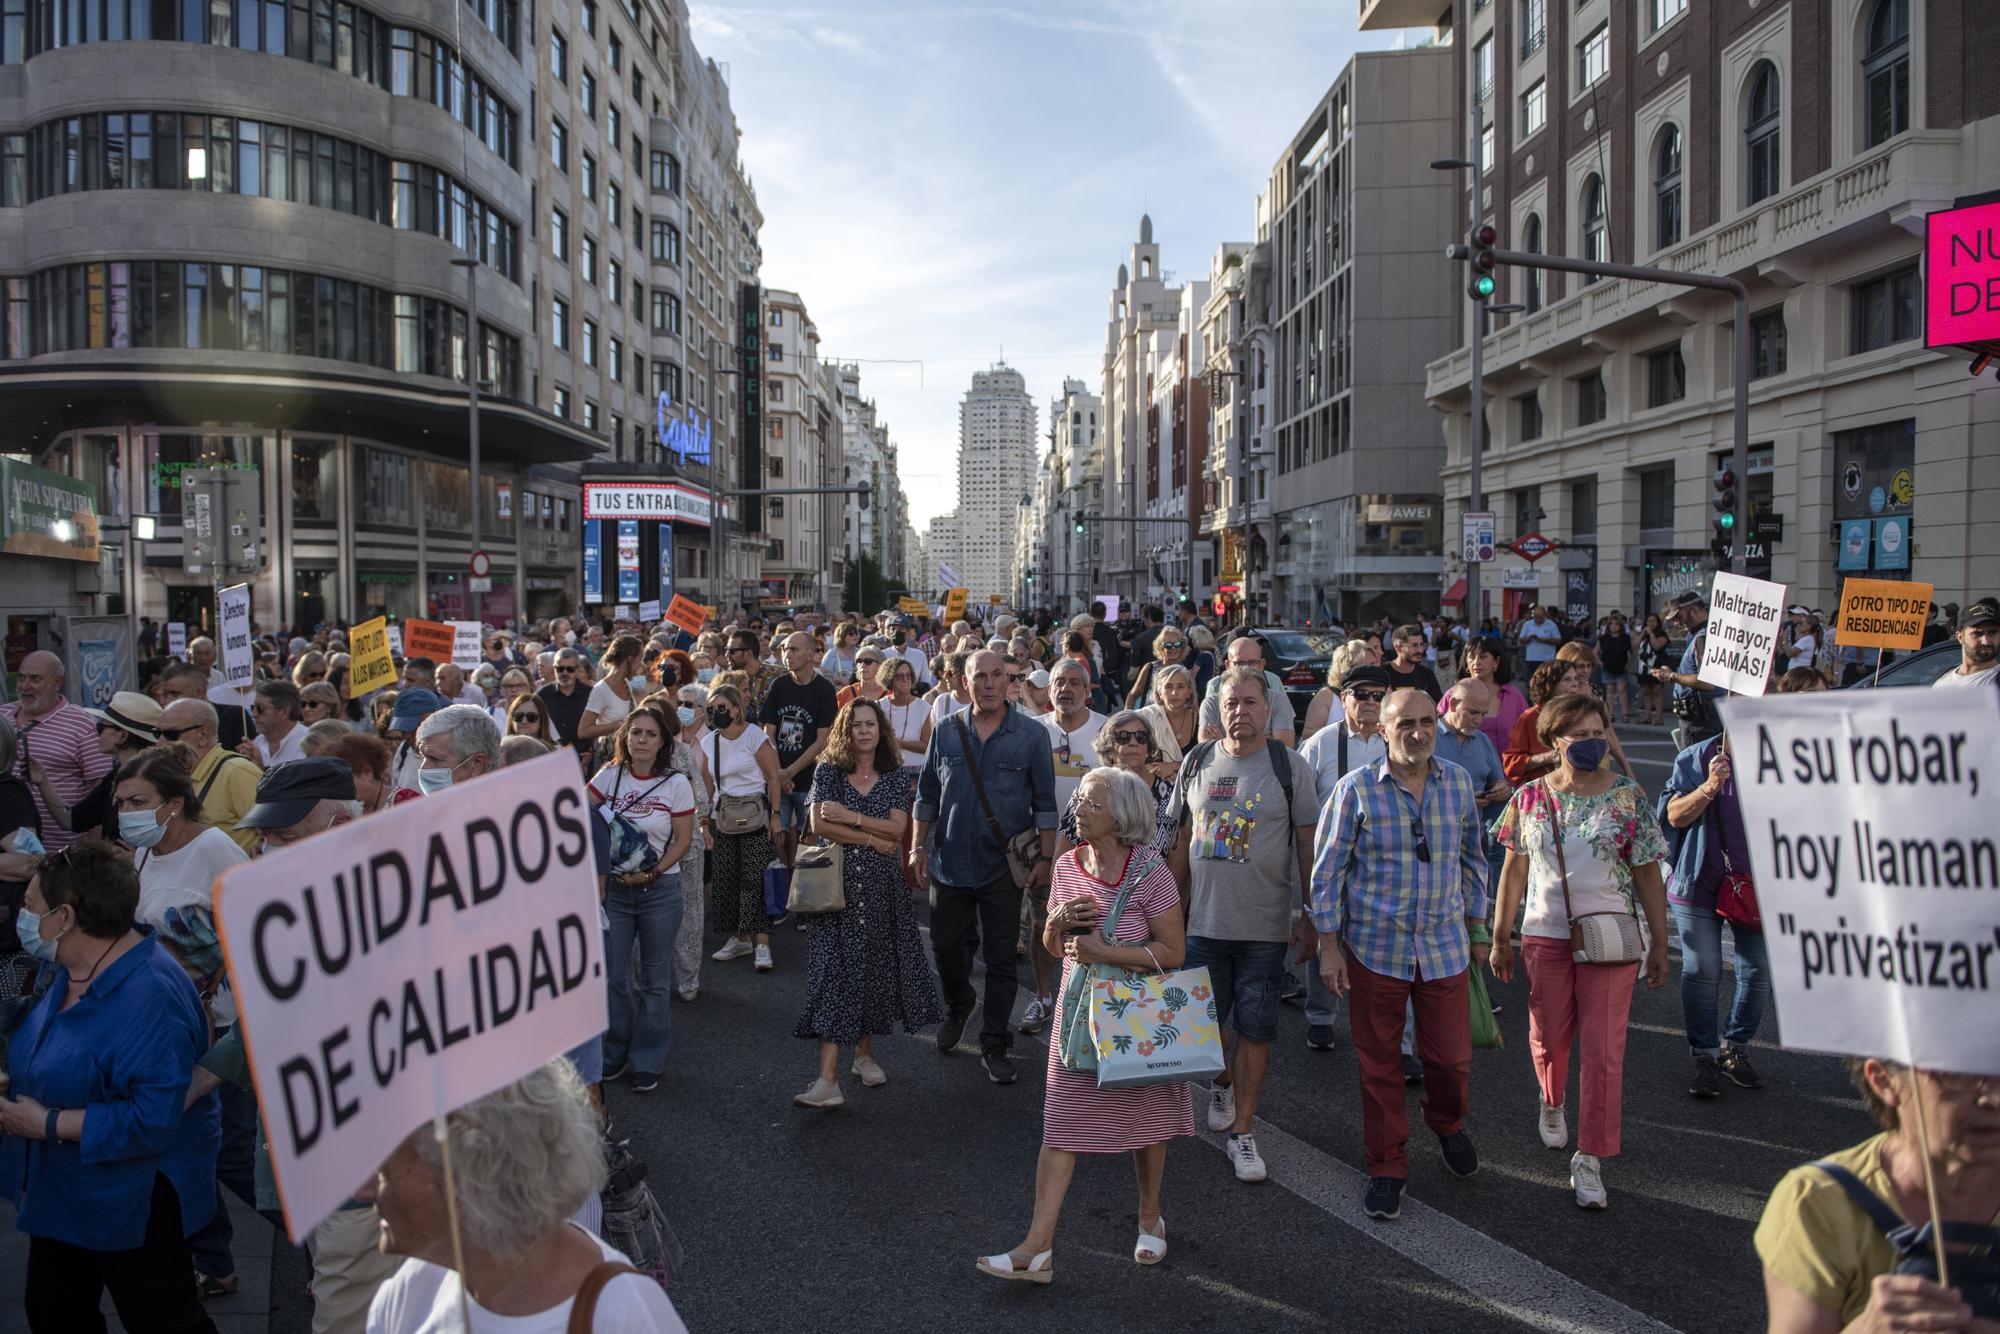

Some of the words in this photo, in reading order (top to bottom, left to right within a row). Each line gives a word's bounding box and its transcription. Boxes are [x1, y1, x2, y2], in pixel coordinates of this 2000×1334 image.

[746, 312, 758, 415] HOTEL
[12, 477, 41, 505] AGUA
[595, 493, 621, 509] TUS
[1523, 542, 1545, 552] Metro
[1568, 603, 1590, 616] LOCAL
[1713, 589, 1778, 623] Maltratar
[1846, 595, 1884, 613] ¡OTRO
[1887, 597, 1909, 613] TIPO
[1911, 599, 1927, 615] DE
[1709, 620, 1722, 637] al
[1724, 625, 1771, 654] mayor,
[1845, 617, 1920, 636] RESIDENCIAS!
[1706, 645, 1766, 678] ¡JAMÁS!
[1757, 723, 1784, 785] A
[1792, 737, 1840, 785] su
[1850, 718, 1979, 797] robar,
[1207, 786, 1237, 796] BAND
[1217, 776, 1239, 786] BEER
[1769, 818, 1841, 898] hoy
[1853, 820, 1999, 889] llaman
[252, 785, 588, 1002] CUIDADOS
[278, 1024, 361, 1158] DE
[367, 912, 602, 1089] CALIDAD.
[1146, 1060, 1182, 1070] NESPRESSO
